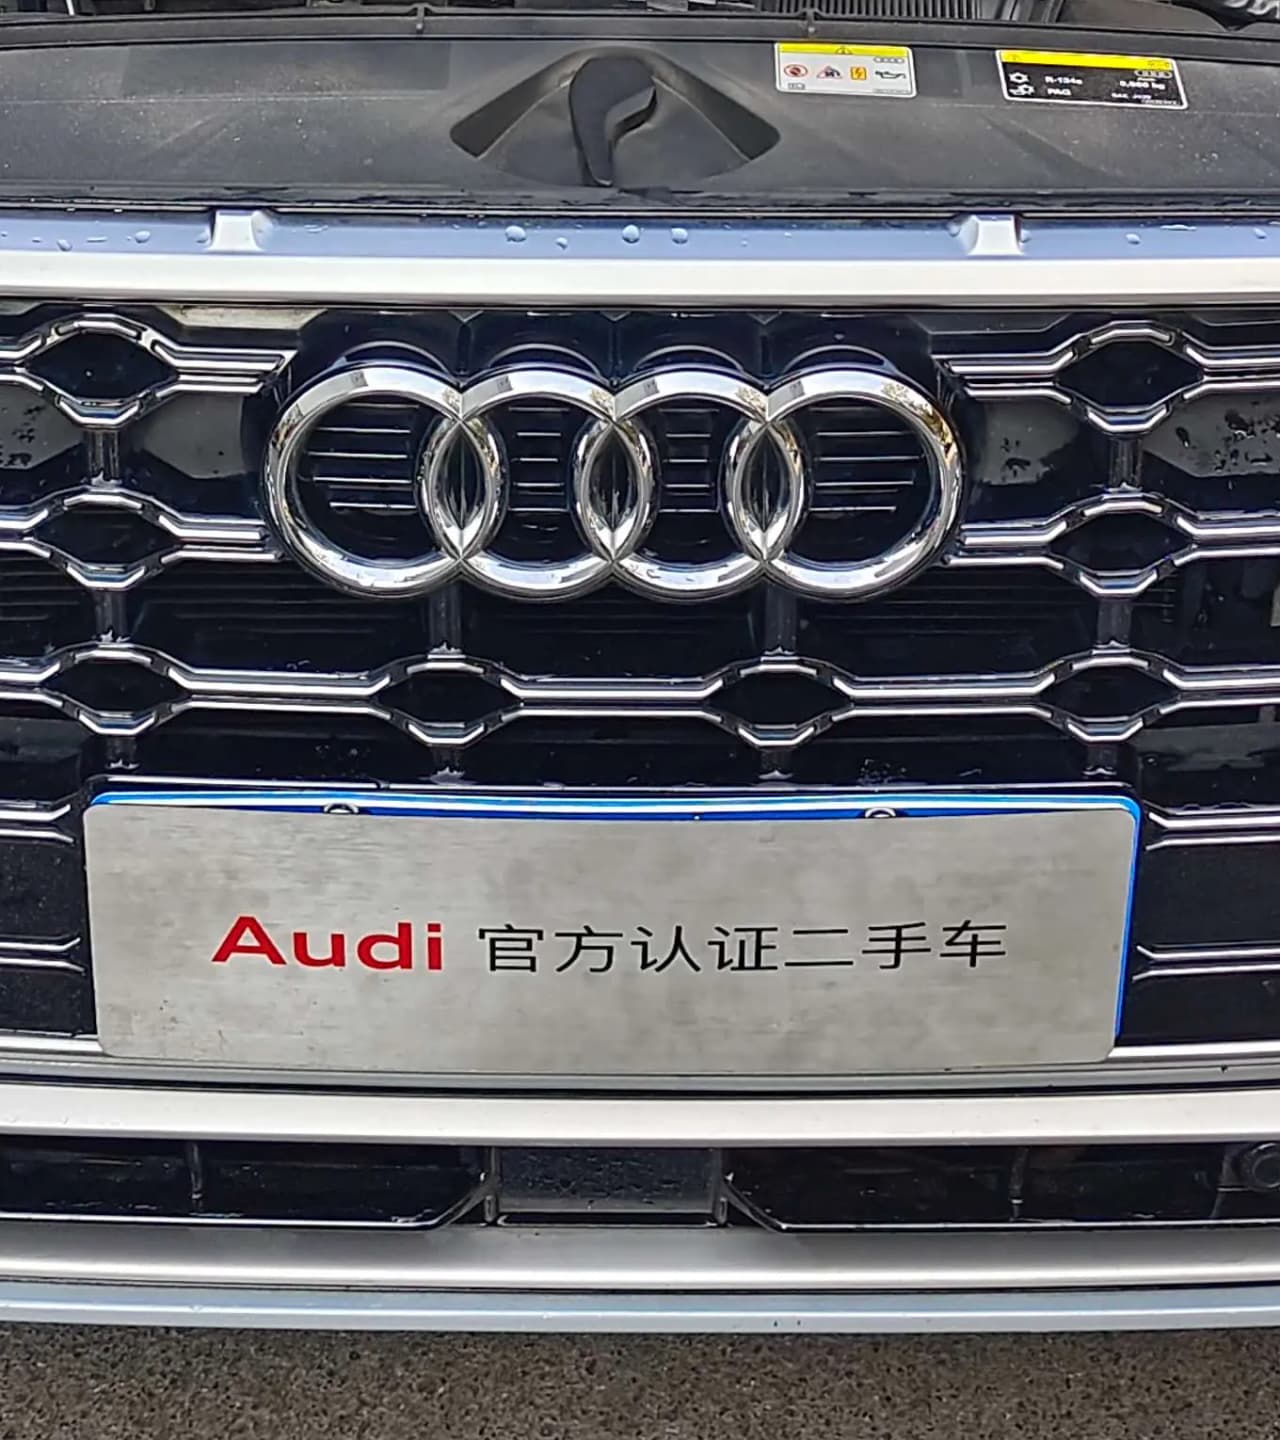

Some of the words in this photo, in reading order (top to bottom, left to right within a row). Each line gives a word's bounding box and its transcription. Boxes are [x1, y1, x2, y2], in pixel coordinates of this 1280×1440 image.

[211, 916, 442, 971] Audi
[478, 920, 1007, 973] 官方认证二手车
